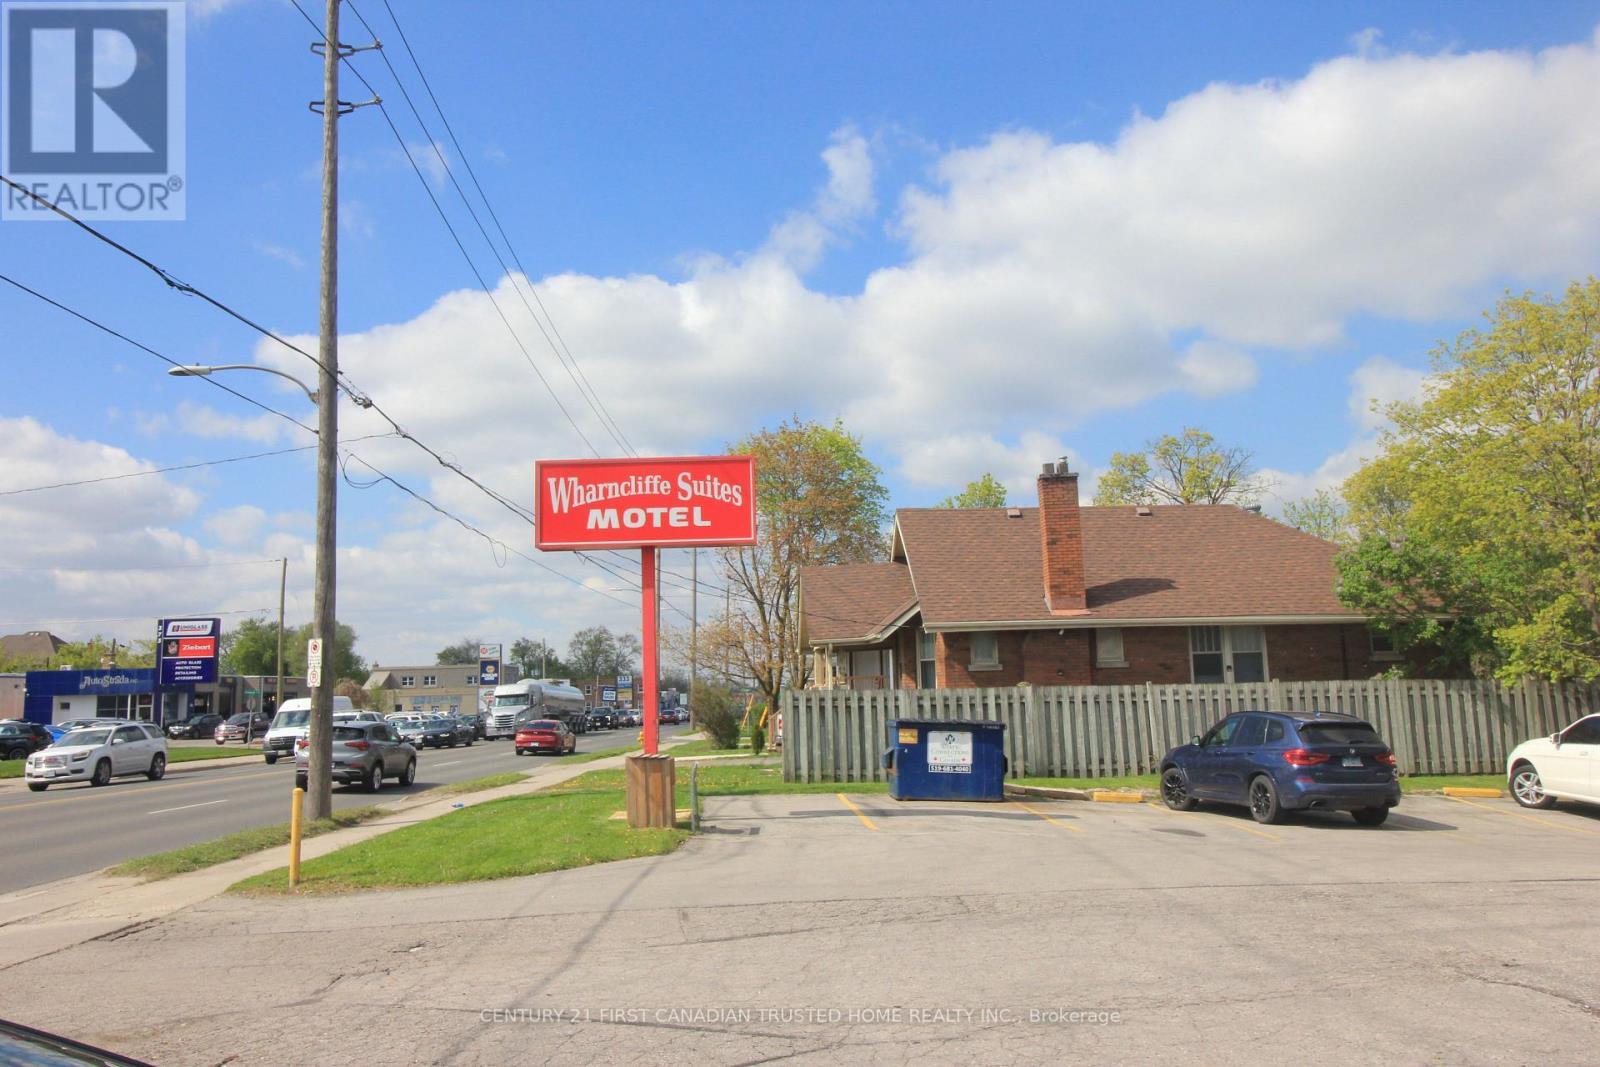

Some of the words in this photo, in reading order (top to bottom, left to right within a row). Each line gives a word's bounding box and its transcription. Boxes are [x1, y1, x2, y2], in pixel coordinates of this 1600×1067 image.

[547, 474, 671, 514] Wharncliffe
[677, 471, 743, 507] Suites
[586, 506, 712, 530] MOTEL
